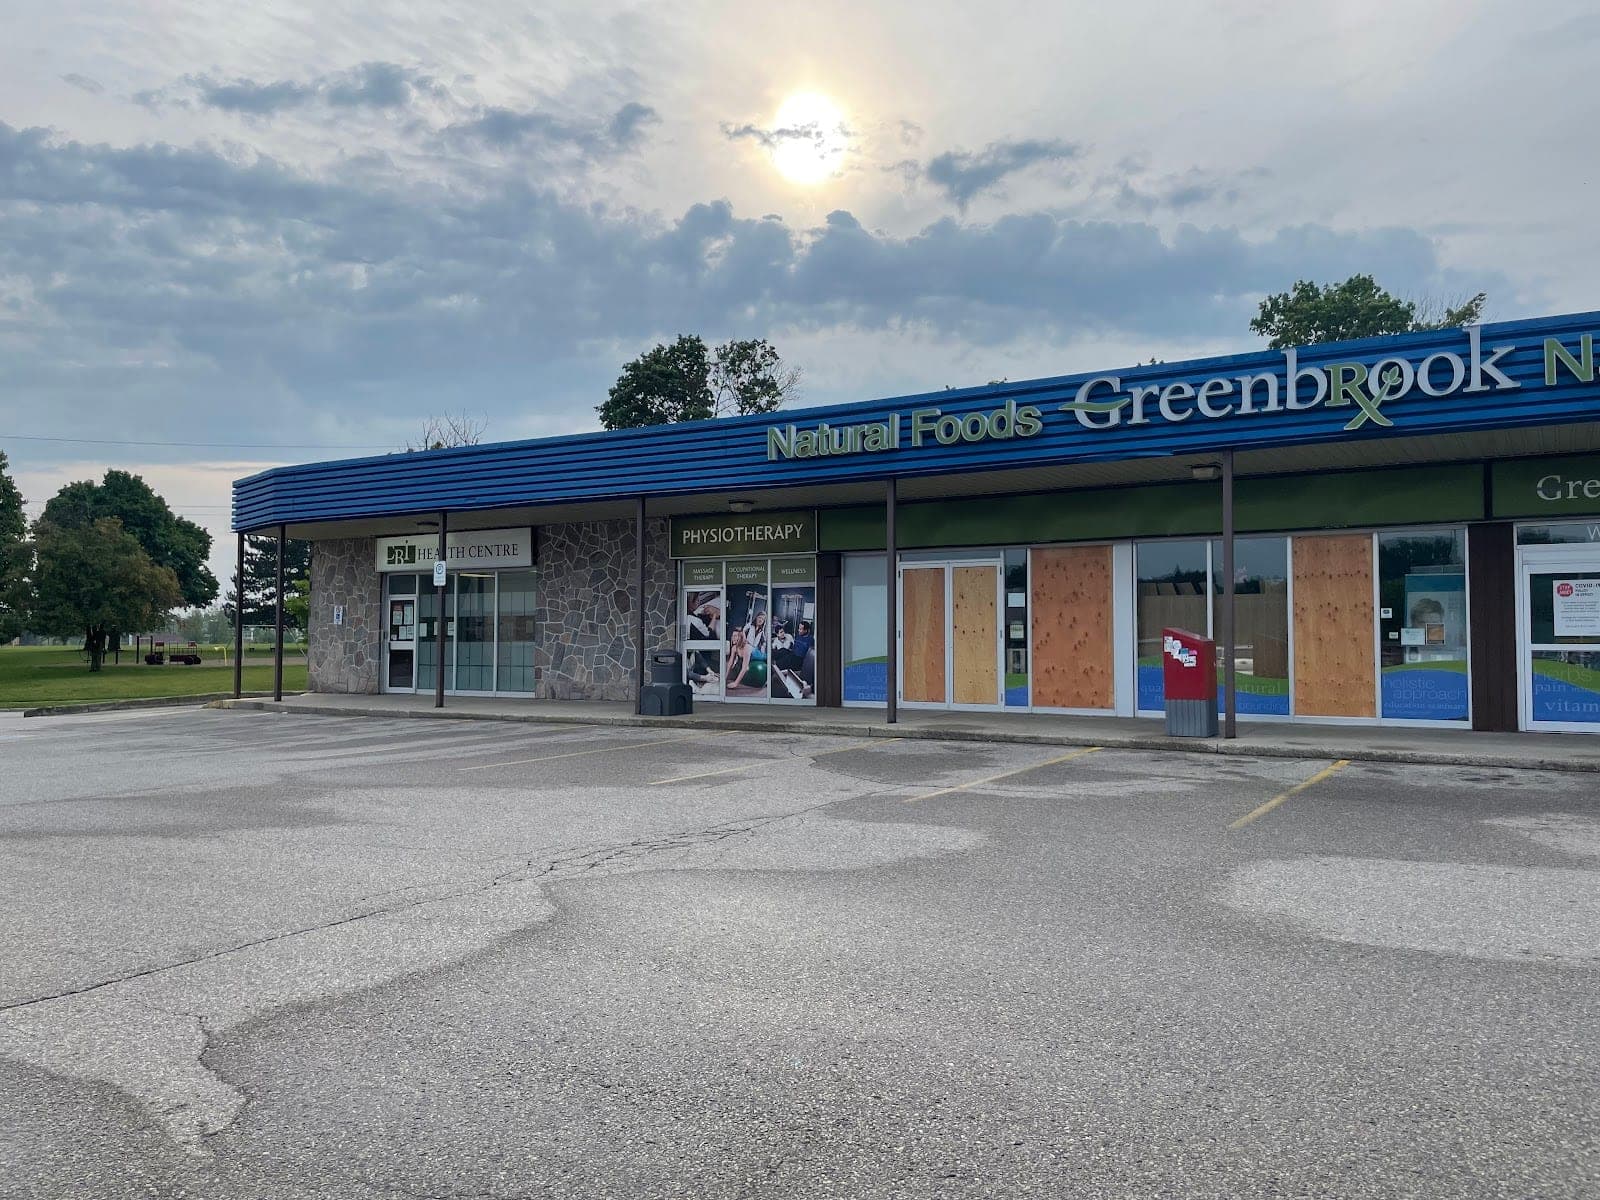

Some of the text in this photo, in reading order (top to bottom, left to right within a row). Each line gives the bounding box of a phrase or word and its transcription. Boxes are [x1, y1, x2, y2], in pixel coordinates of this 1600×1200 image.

[1543, 333, 1600, 386] N
[766, 399, 1044, 462] Natural Foods
[682, 523, 804, 545] PHYSIOTHERAPY
[418, 543, 519, 561] HEATH CENTRE
[780, 567, 807, 575] WELLNESS
[1383, 675, 1436, 690] holistic
[1392, 688, 1467, 703] approach
